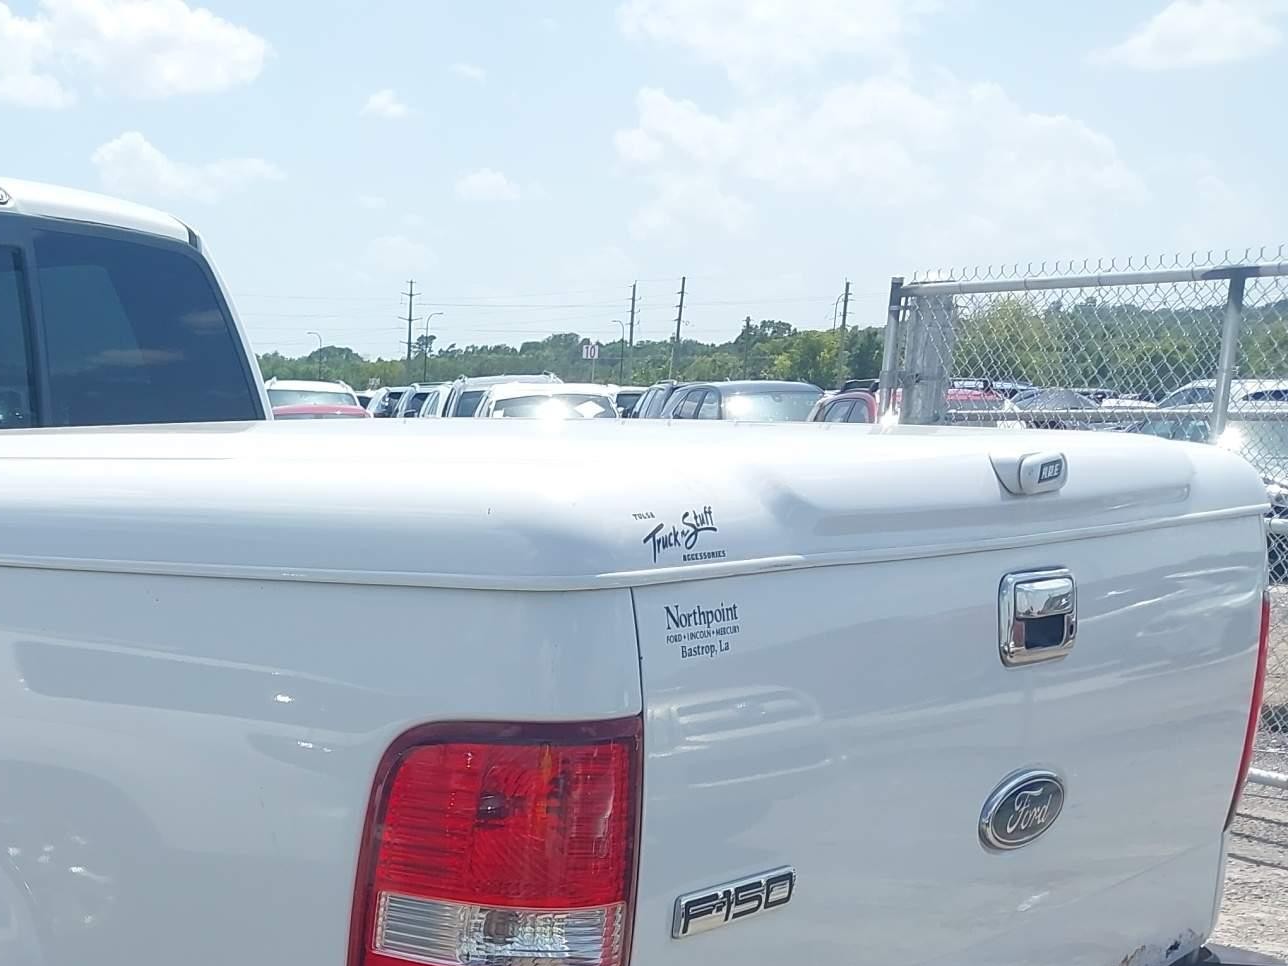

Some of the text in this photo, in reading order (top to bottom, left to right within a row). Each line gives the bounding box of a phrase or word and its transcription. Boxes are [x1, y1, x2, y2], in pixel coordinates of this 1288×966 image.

[585, 345, 596, 358] 10
[631, 511, 656, 521] TULSA
[643, 522, 681, 564] Truck
[682, 505, 718, 550] Stuff
[682, 549, 727, 562] ACCESSORIES
[664, 601, 739, 630] Northpoint
[666, 624, 740, 644] FORD LINCOLN MERCURY
[680, 639, 730, 658] Bastrop, La
[1006, 786, 1052, 834] Ford
[679, 869, 794, 936] F-150
